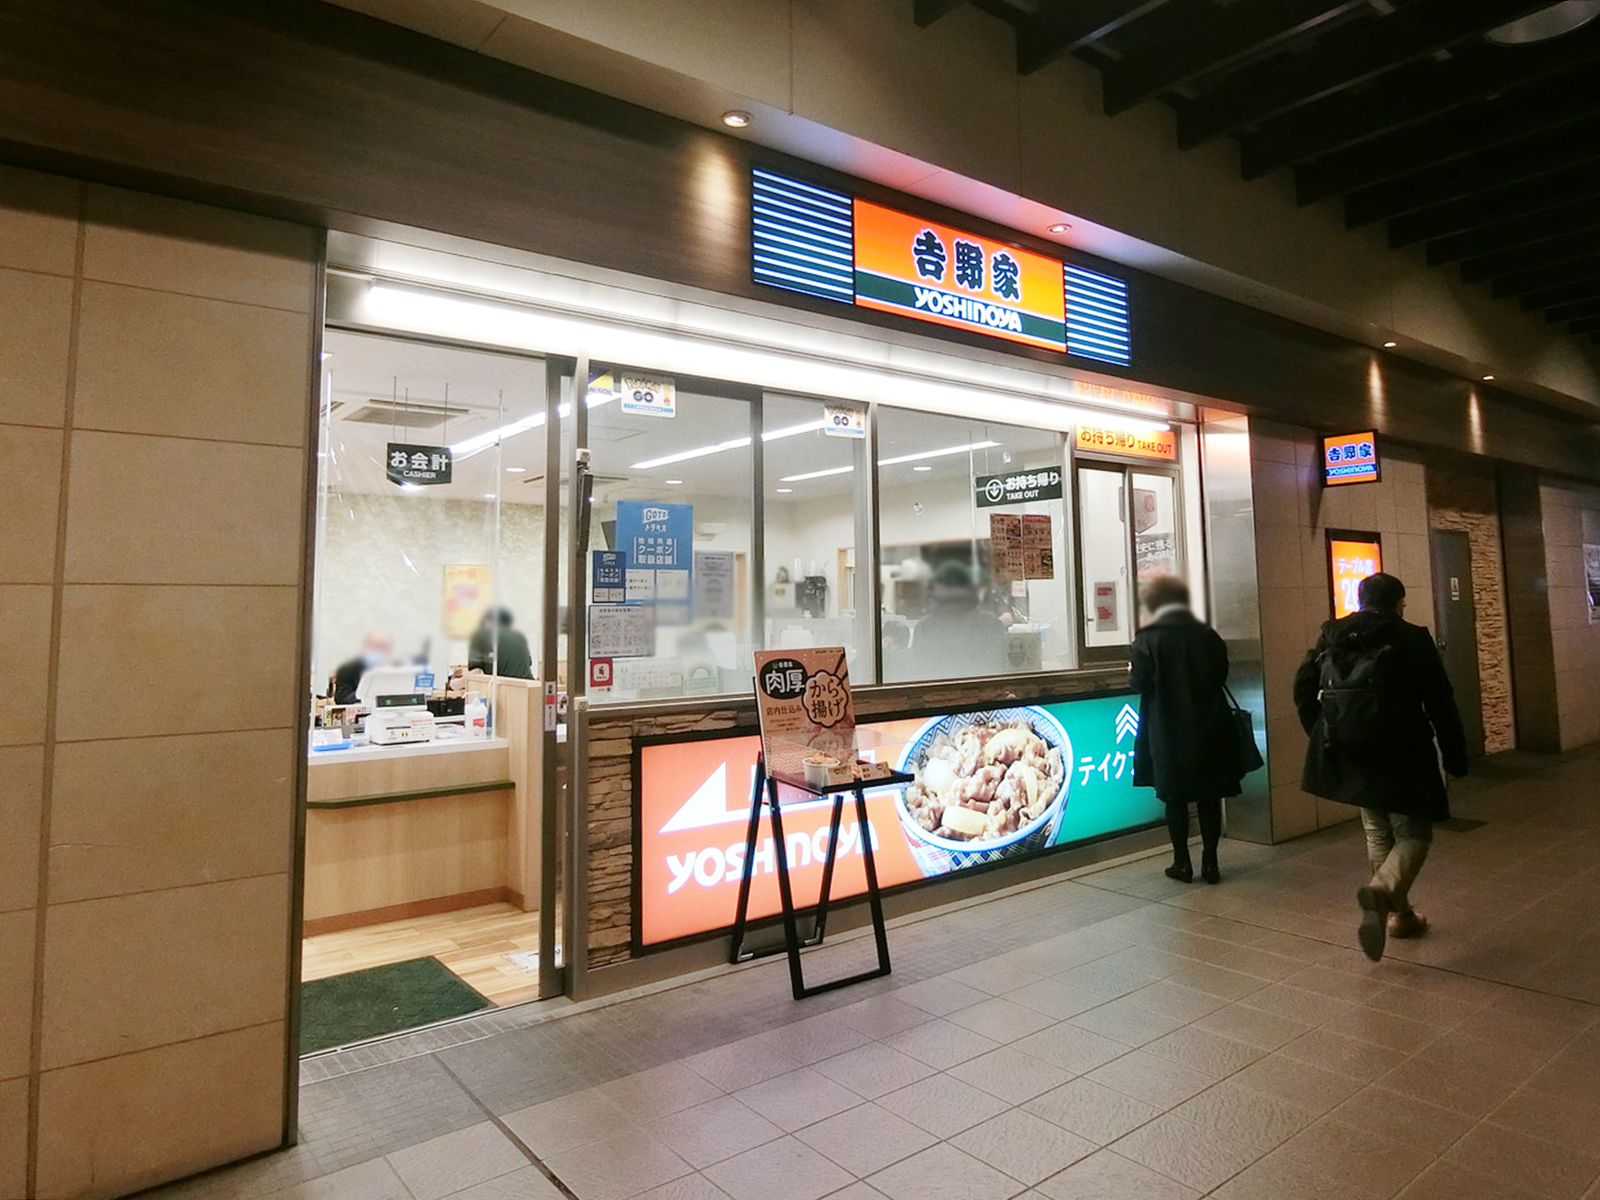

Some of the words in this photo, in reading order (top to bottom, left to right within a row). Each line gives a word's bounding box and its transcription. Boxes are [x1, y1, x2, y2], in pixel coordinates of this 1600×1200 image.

[911, 229, 1021, 302] 吉野家
[914, 287, 1022, 332] YOSHINOYA
[633, 390, 653, 402] GO
[833, 415, 849, 426] GO
[1081, 426, 1135, 448] お持ち帰り
[1137, 440, 1156, 452] TAKE
[1157, 443, 1172, 454] OUT
[390, 450, 449, 472] お会計
[1328, 442, 1373, 462] 吉野家
[403, 470, 437, 479] CASHIER
[1329, 465, 1375, 476] YOSHINOYA
[1005, 471, 1060, 491] お持ち帰り
[1006, 491, 1023, 500] TAKE
[1024, 489, 1039, 498] OUT
[638, 545, 673, 555] クーポン
[638, 555, 673, 565] 取扱店舗
[765, 669, 805, 695] 肉厚
[809, 678, 839, 698] から
[766, 704, 802, 716] 店内仕込み
[811, 697, 845, 719] 揚げ
[666, 819, 879, 895] YOSHNOYA
